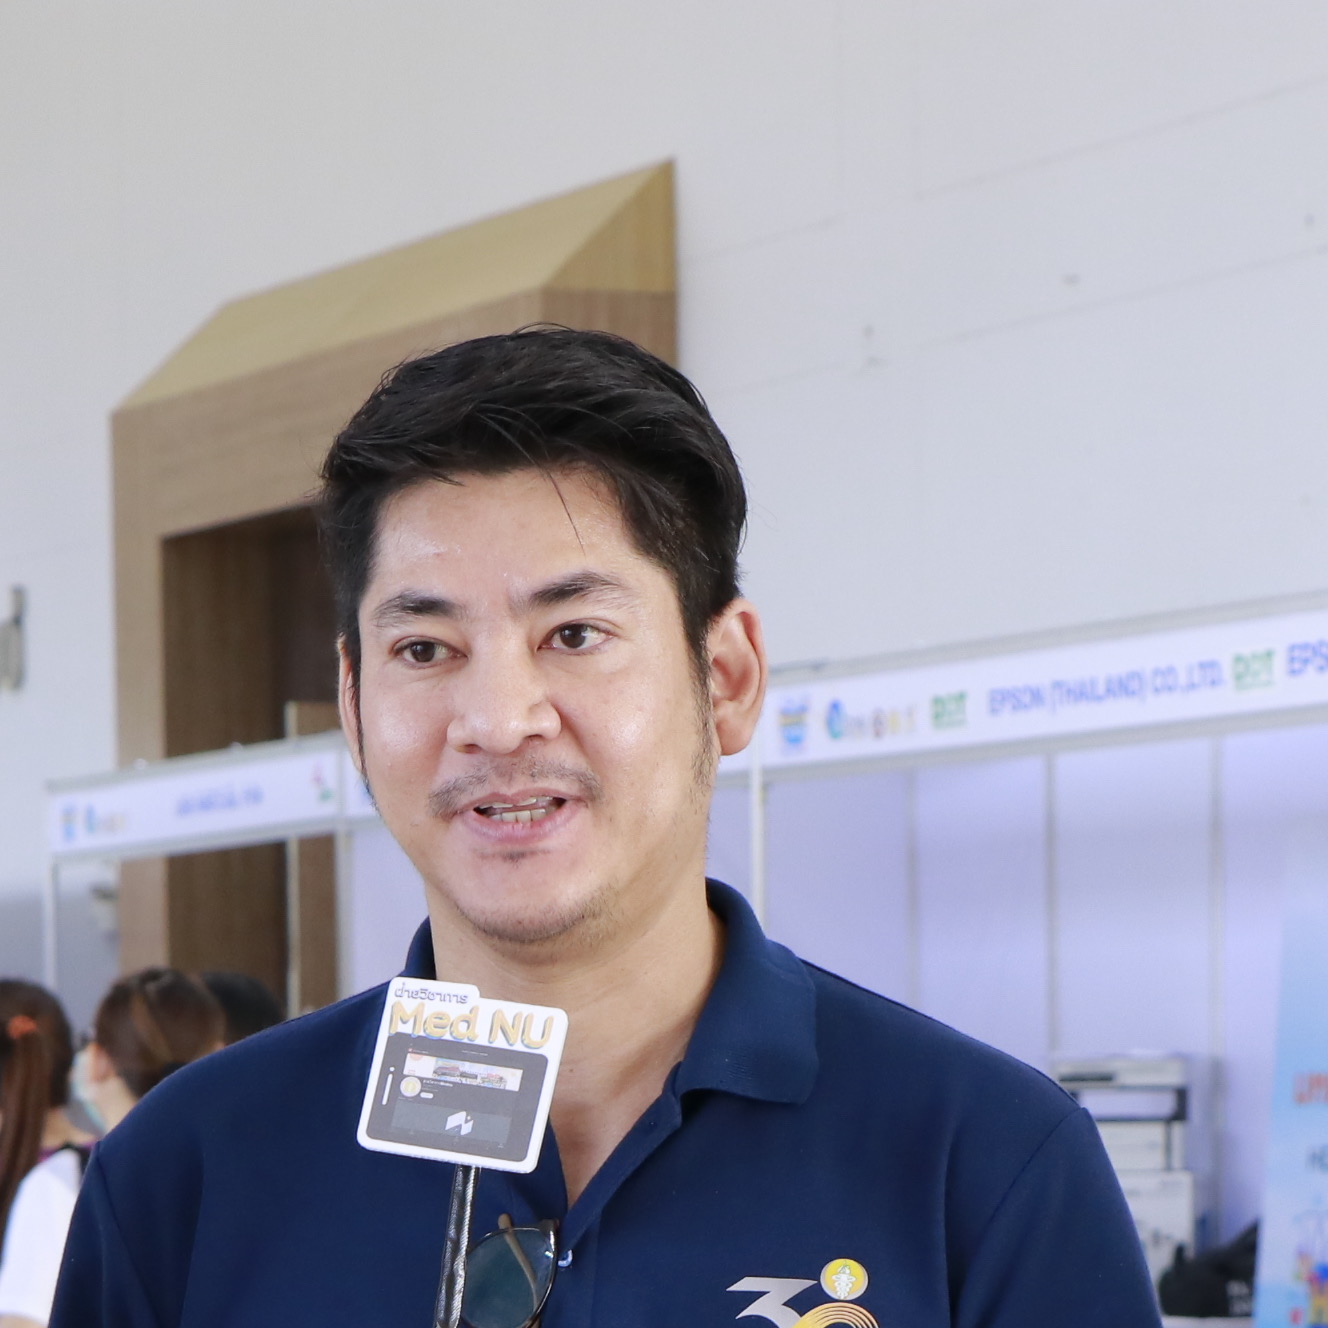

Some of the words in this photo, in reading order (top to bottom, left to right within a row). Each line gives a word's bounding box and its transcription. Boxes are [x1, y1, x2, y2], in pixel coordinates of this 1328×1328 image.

[987, 686, 1046, 717] EPSON
[1048, 669, 1146, 714] (THAILAND)
[388, 1000, 480, 1042] Med
[487, 1008, 554, 1049] NU
